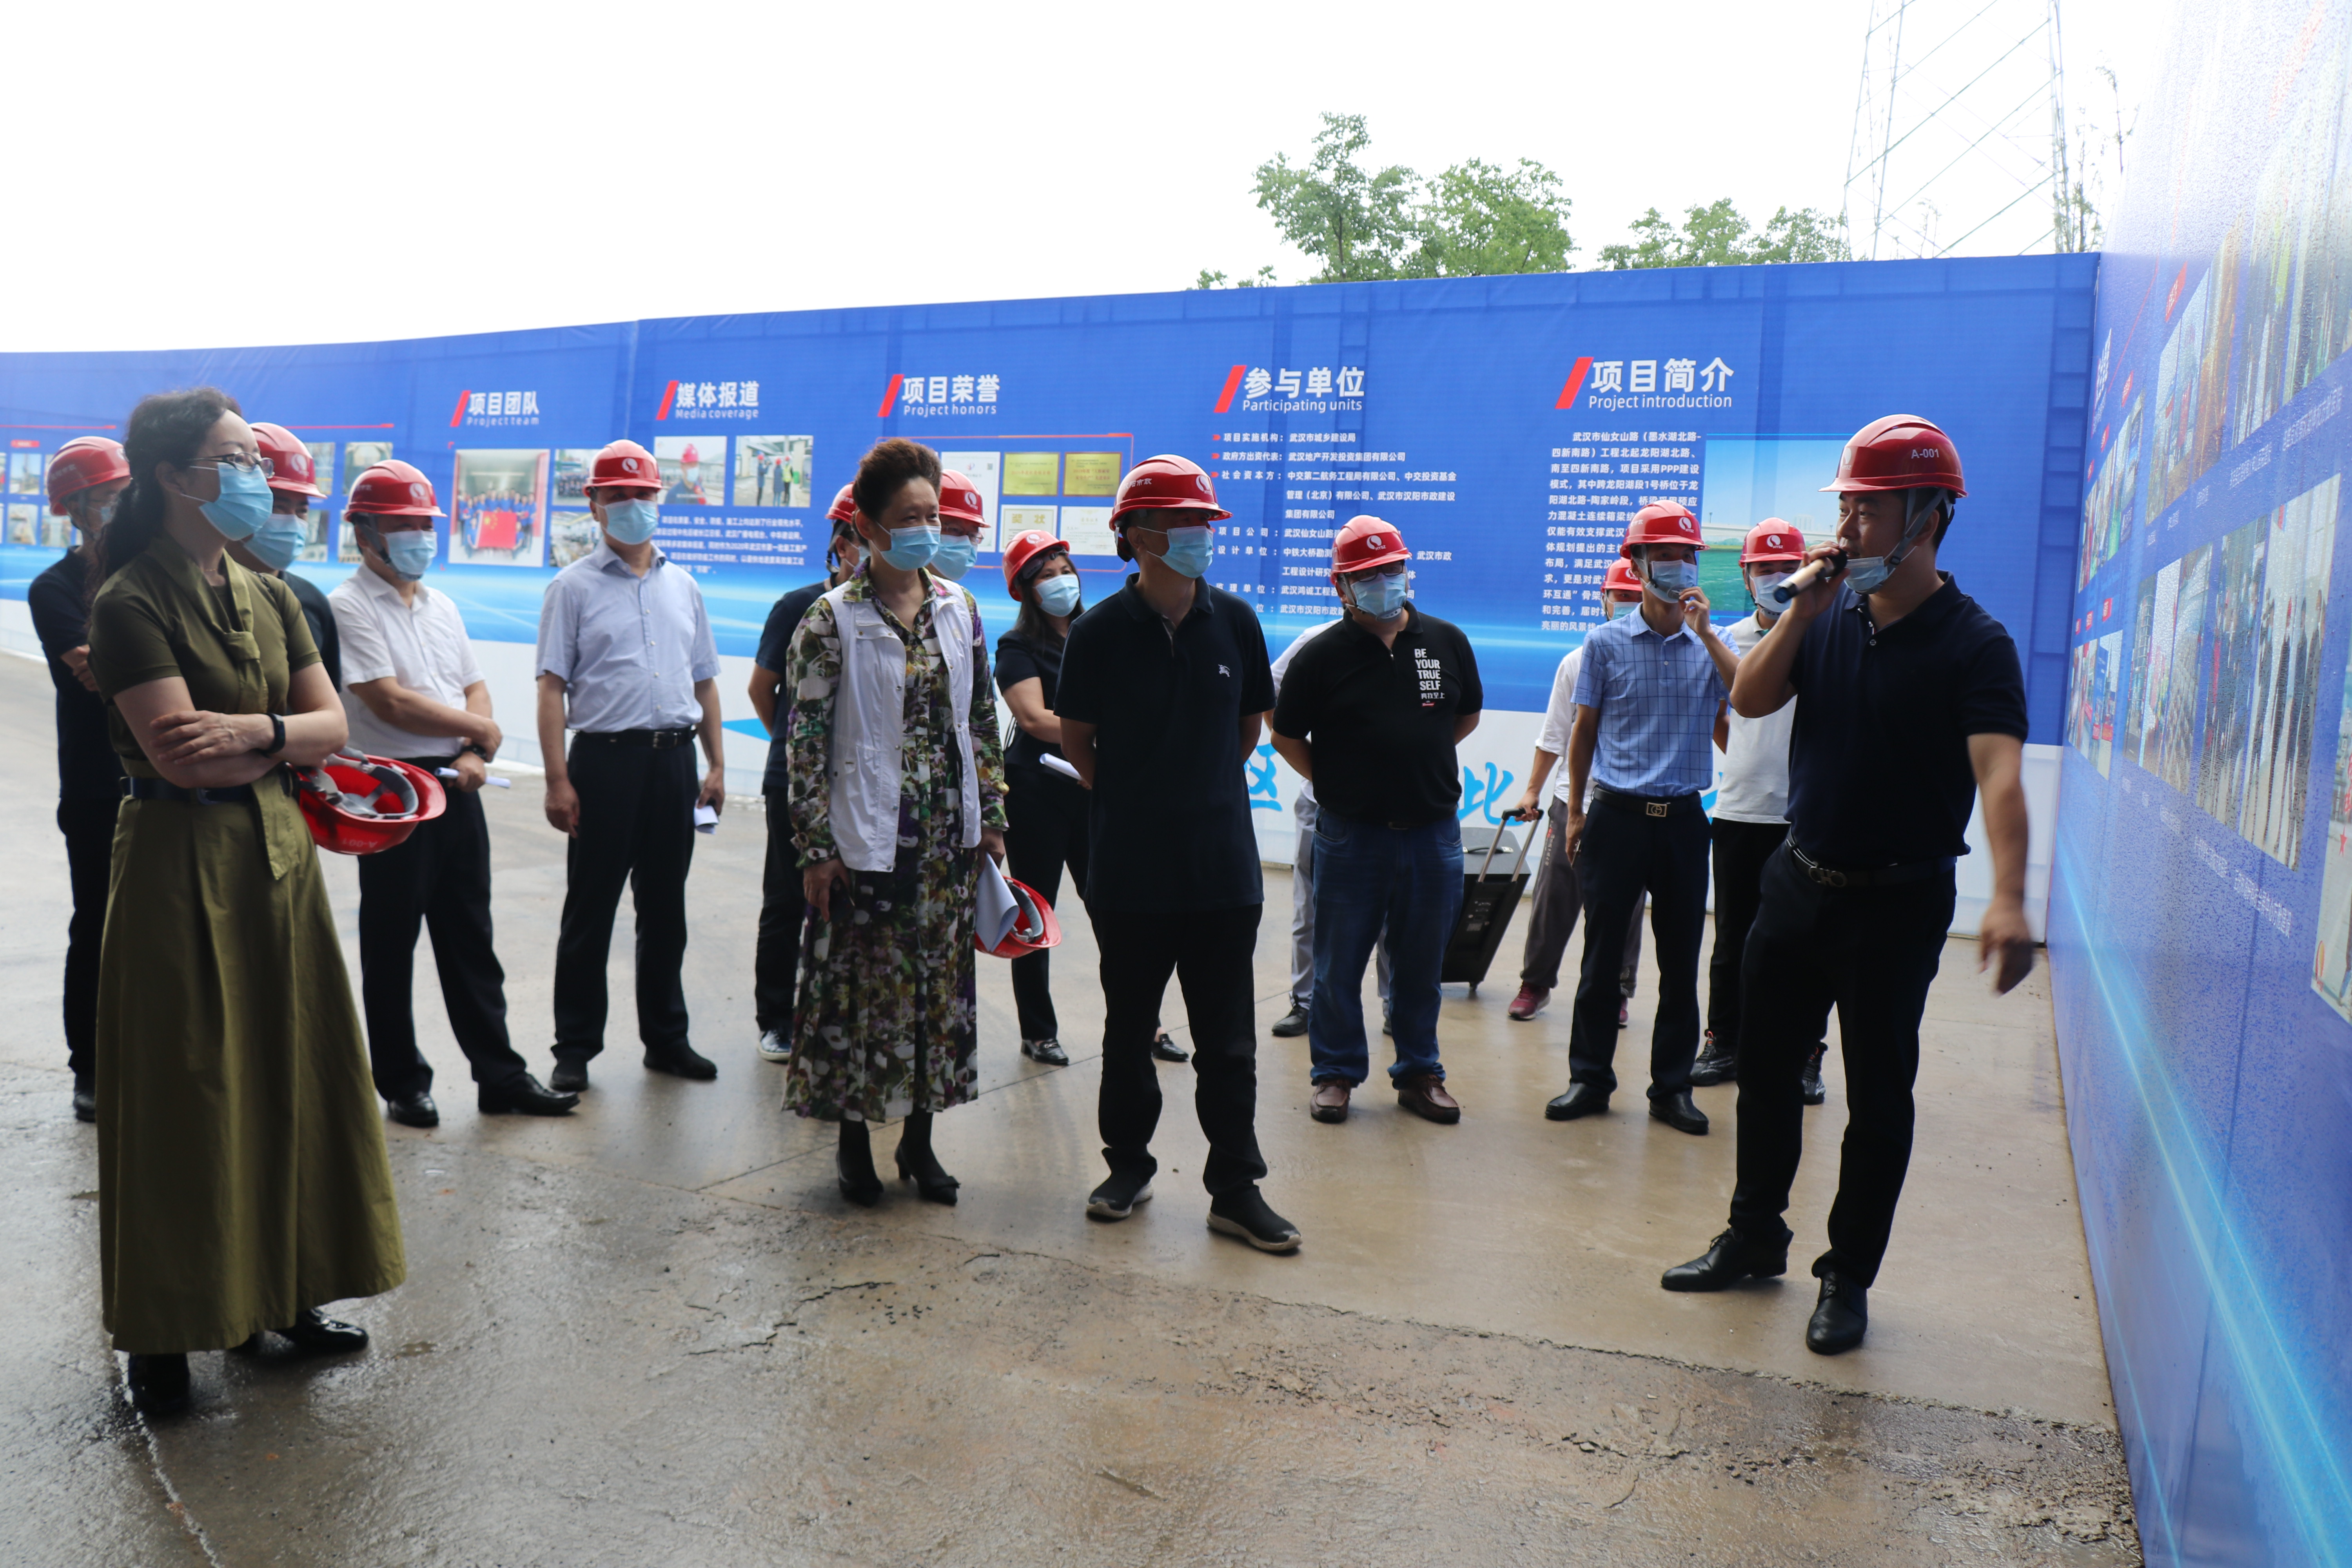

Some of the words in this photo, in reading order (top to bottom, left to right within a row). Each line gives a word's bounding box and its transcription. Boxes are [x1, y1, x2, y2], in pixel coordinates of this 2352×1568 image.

[1590, 357, 1735, 393] 项目简介
[1243, 366, 1366, 399] 参与单位
[675, 381, 759, 408] 媒体报道
[902, 374, 1000, 405] 项目荣誉
[468, 391, 539, 416] 项目团队
[1243, 399, 1327, 414] Participating
[1330, 399, 1363, 411] units
[1589, 395, 1639, 411] Project
[1642, 394, 1733, 408] introduction
[675, 408, 706, 419] Media
[709, 409, 759, 420] coverage
[904, 404, 949, 417] Project
[952, 403, 997, 415] honors
[466, 417, 508, 427] Project
[510, 416, 539, 425] team
[1289, 433, 1356, 443] 武汉市城乡建设局
[1288, 452, 1406, 462] 武汉地产开发投资集团有限公司
[1911, 448, 1940, 459] A-001
[1285, 509, 1335, 519] 集团有限公司
[1283, 548, 1332, 557] 中铁大桥勘测
[1417, 550, 1452, 561] 武汉市政
[1282, 567, 1331, 577] 工程设计研究
[1544, 574, 1606, 584] 求，更是对武
[1414, 648, 1427, 658] BE
[1415, 659, 1441, 669] YOUR
[1417, 670, 1441, 679] TRUE
[1419, 680, 1441, 691] SELF
